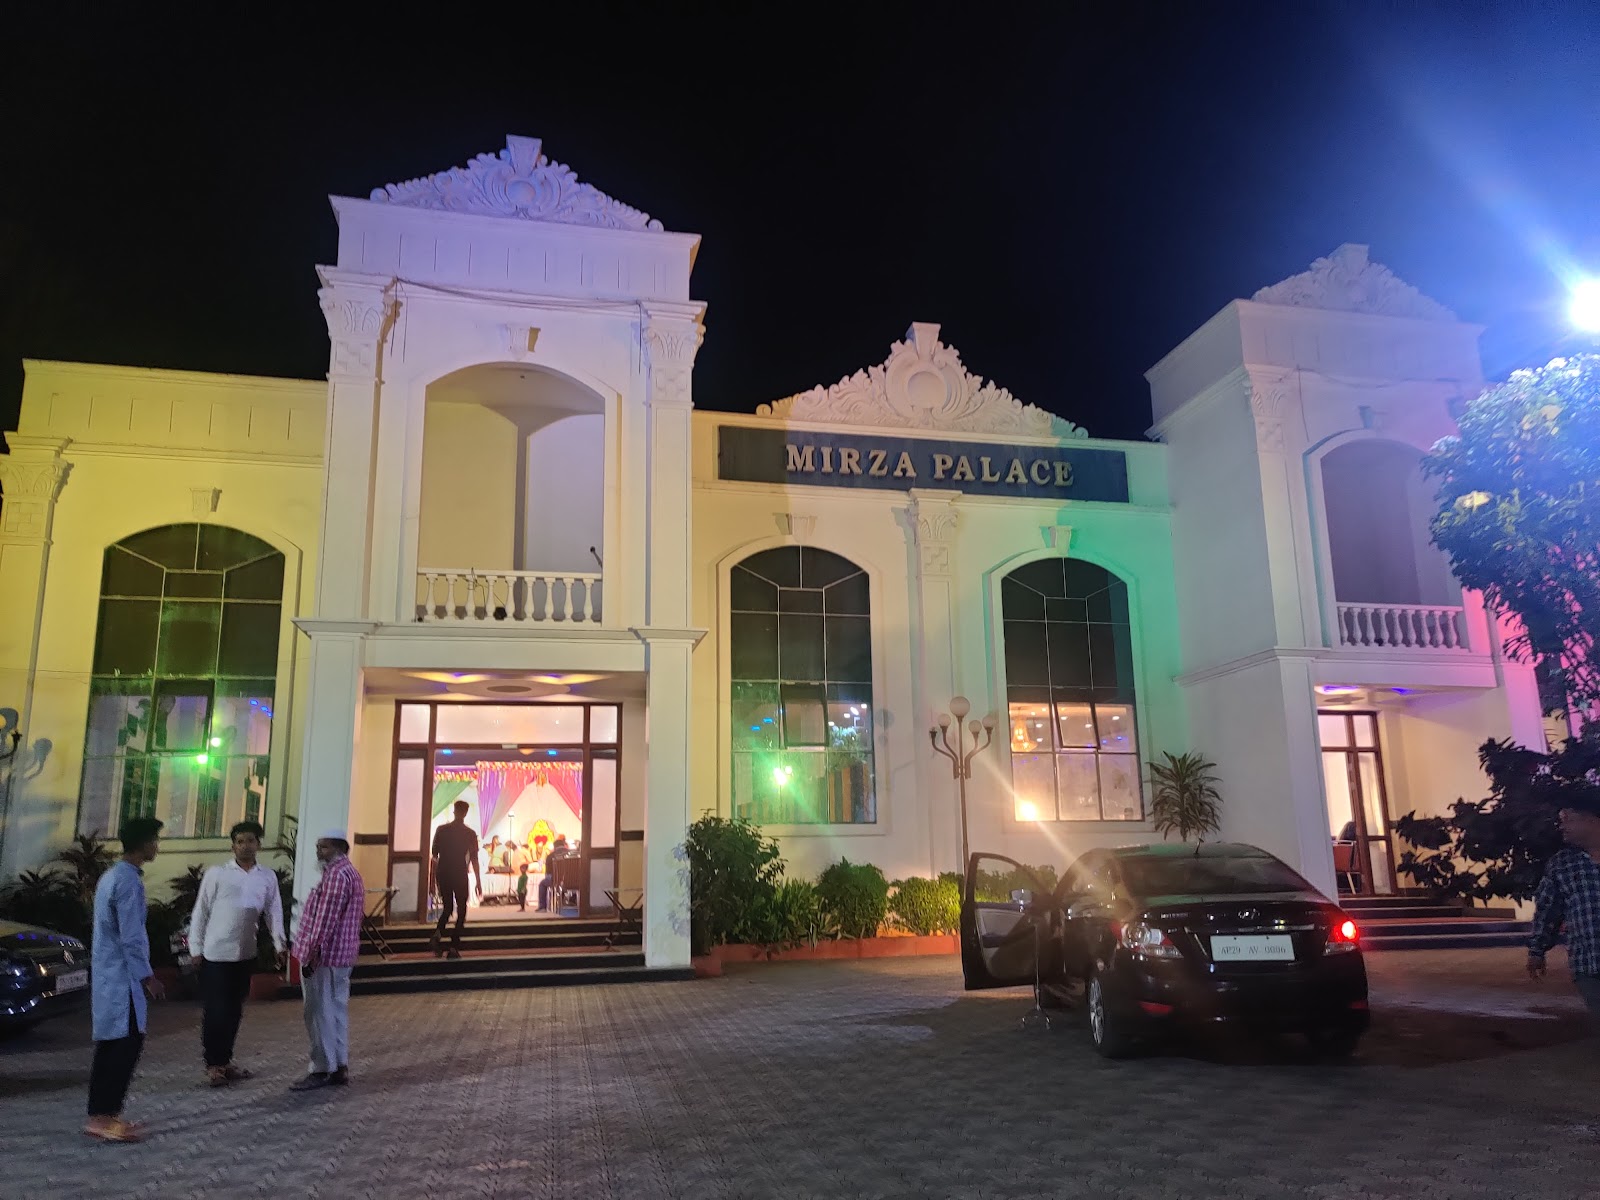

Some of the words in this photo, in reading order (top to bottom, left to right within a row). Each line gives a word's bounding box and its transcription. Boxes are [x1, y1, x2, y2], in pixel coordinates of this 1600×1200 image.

[786, 443, 917, 477] MIRZA
[932, 453, 1074, 487] PALACE
[1221, 945, 1241, 955] AP29
[1248, 945, 1260, 955] AV
